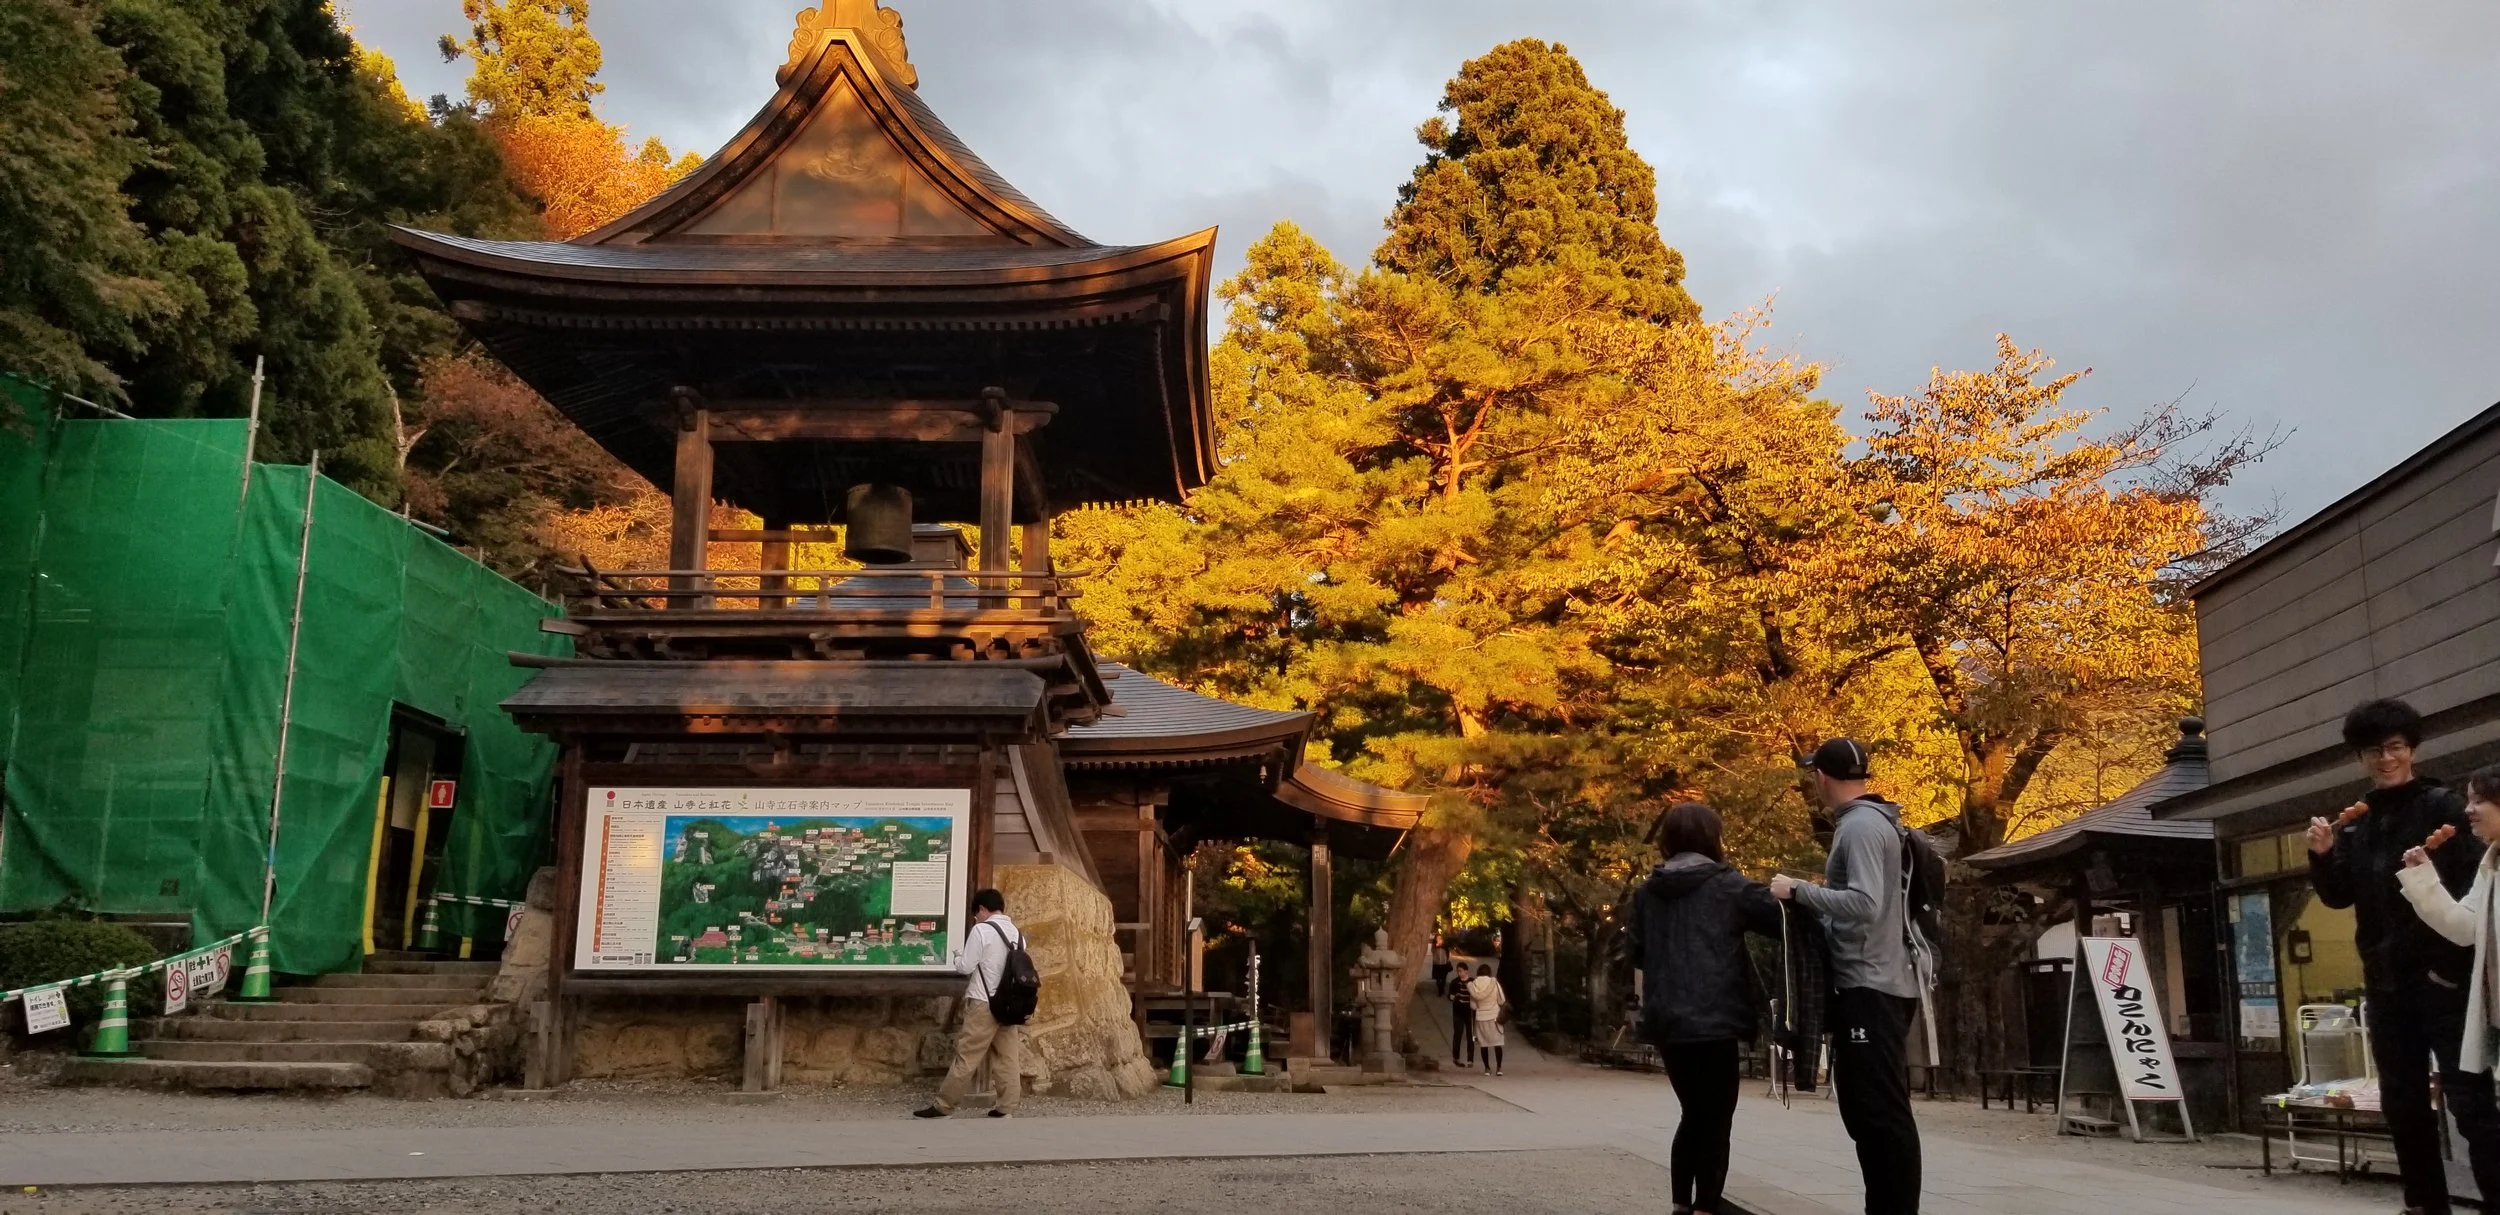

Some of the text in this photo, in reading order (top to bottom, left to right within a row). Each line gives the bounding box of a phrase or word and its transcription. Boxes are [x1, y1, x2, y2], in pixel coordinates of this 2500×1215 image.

[622, 800, 732, 810] 日本遺産 山寺と紅花
[755, 800, 863, 810] 山寺立石寺案内マップ
[2110, 985, 2166, 1090] 力こんにゃく
